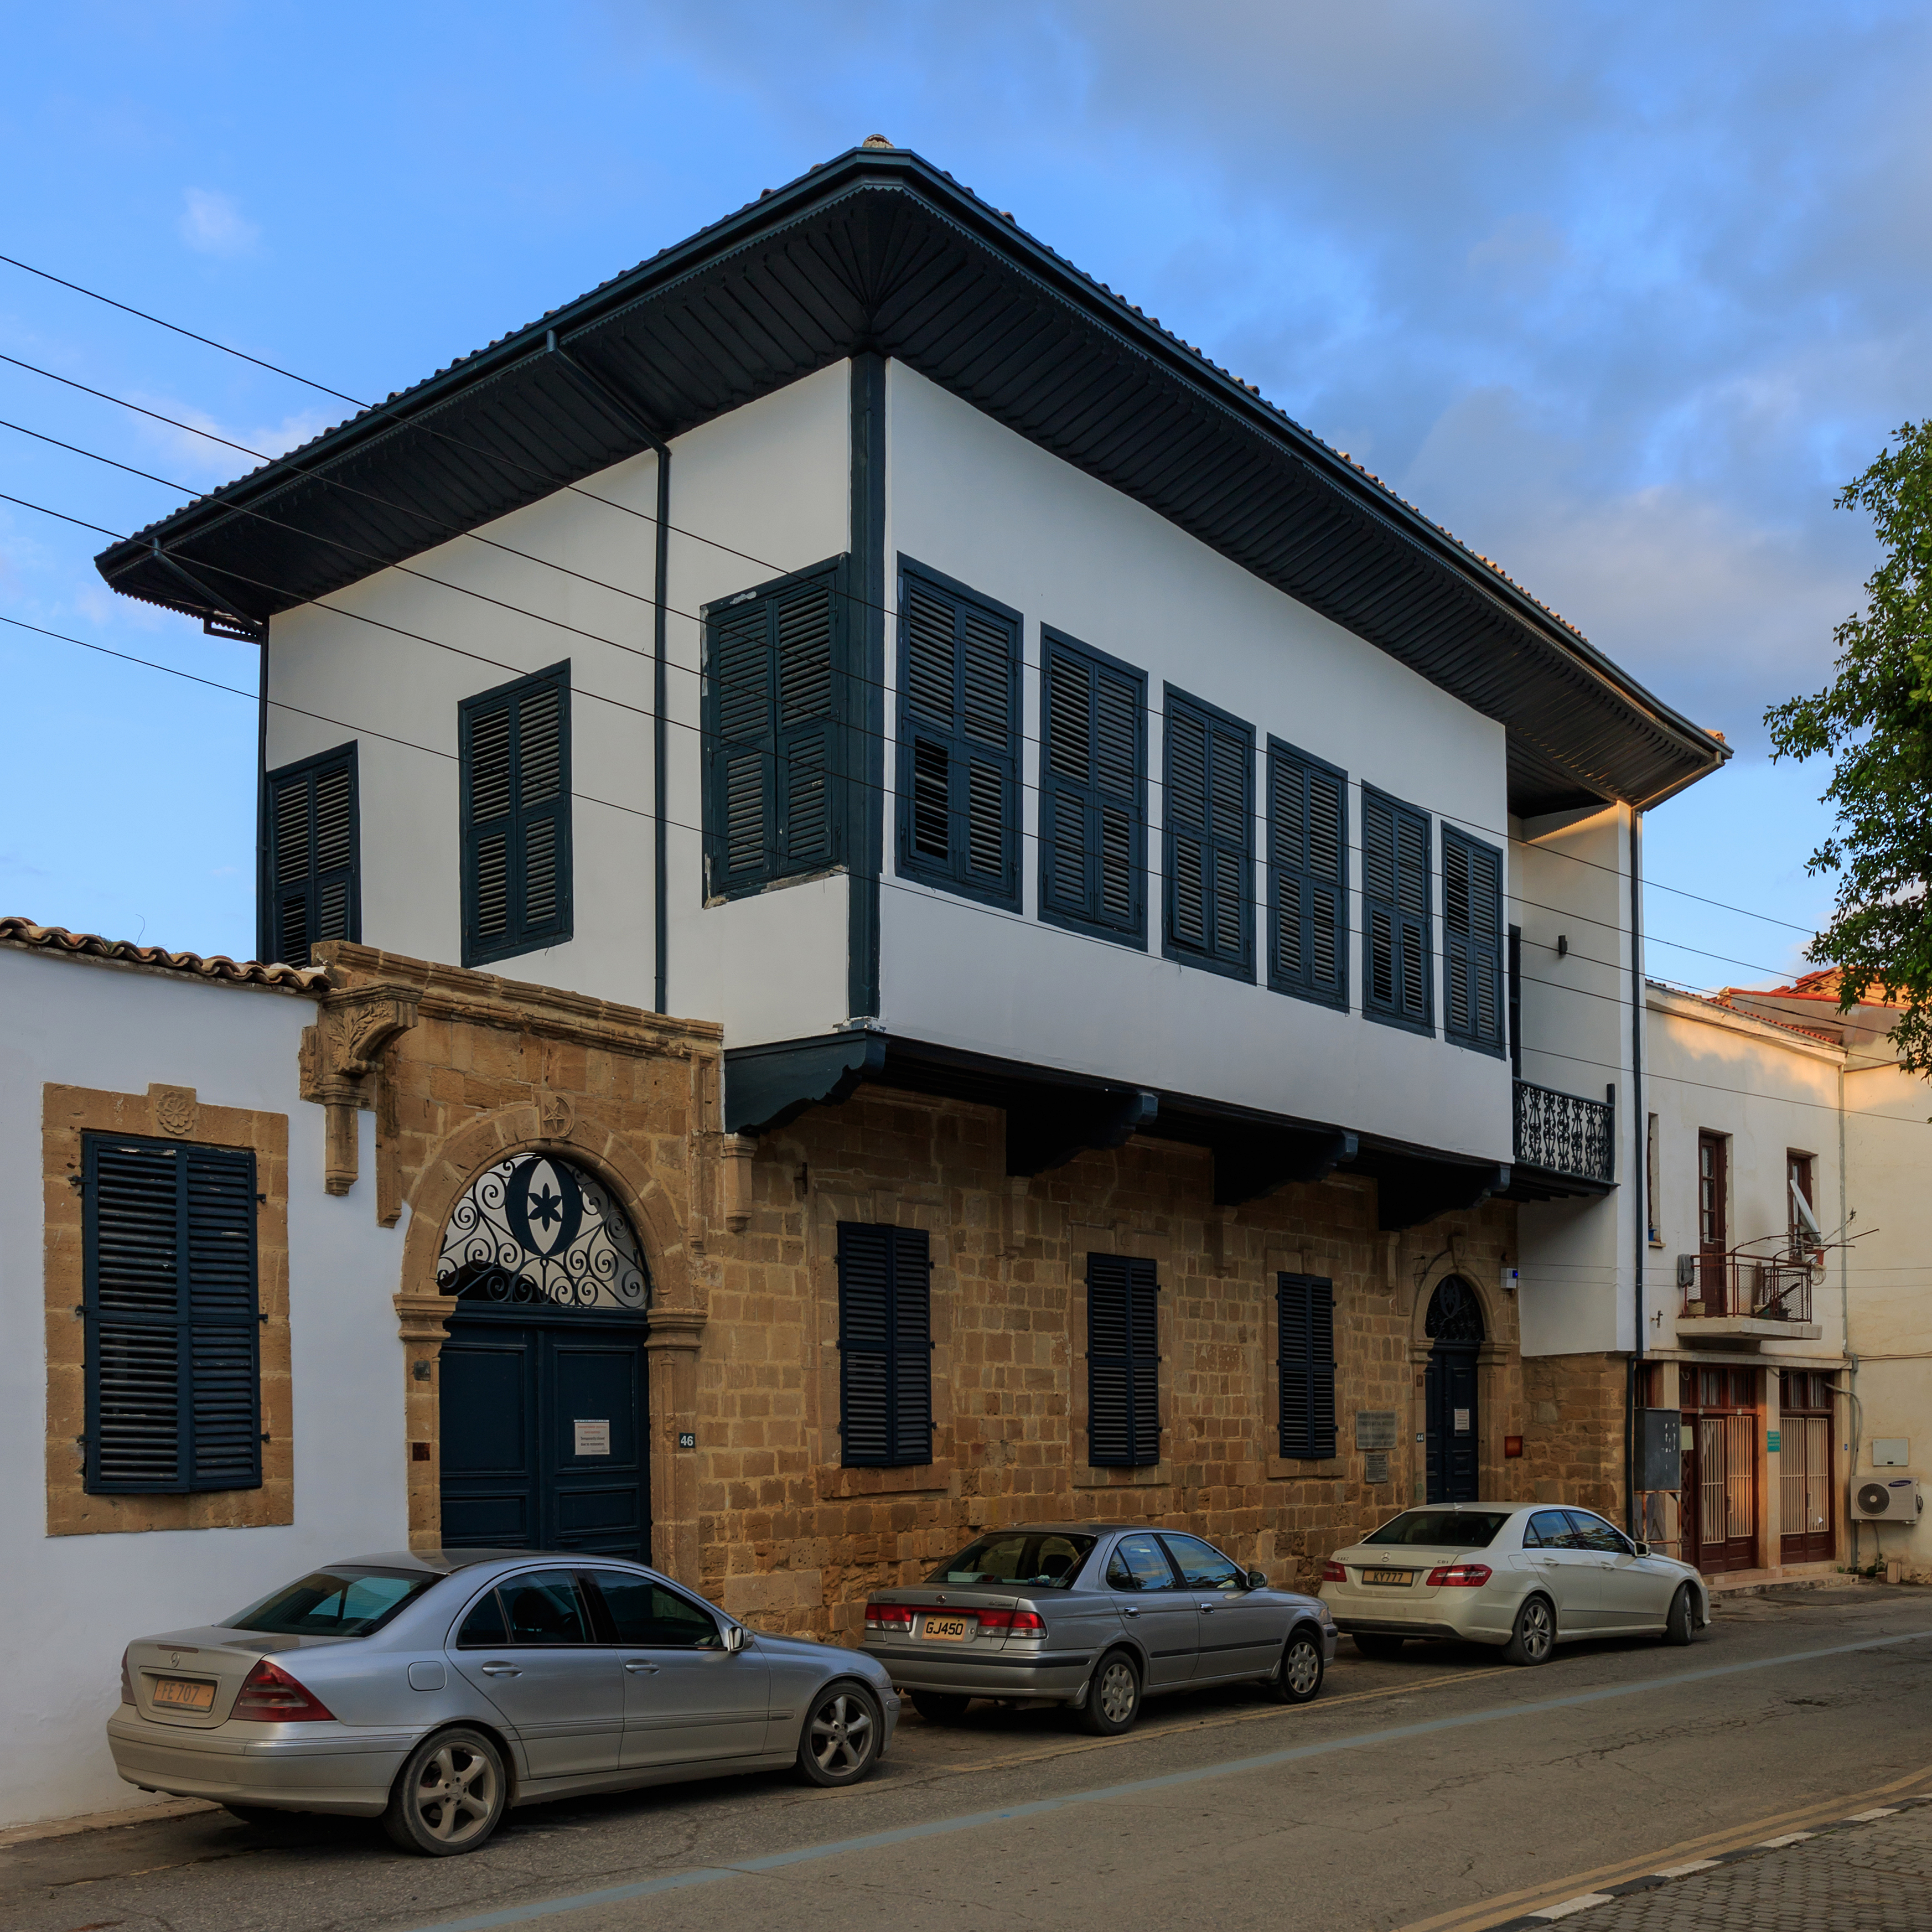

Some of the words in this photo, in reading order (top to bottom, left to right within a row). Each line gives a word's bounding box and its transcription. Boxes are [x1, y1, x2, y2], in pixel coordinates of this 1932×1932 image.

[681, 1436, 693, 1446] 46
[1374, 1572, 1403, 1582] KY777
[926, 1622, 964, 1635] GJ450
[161, 1682, 176, 1700] FE
[176, 1684, 200, 1703] 707
